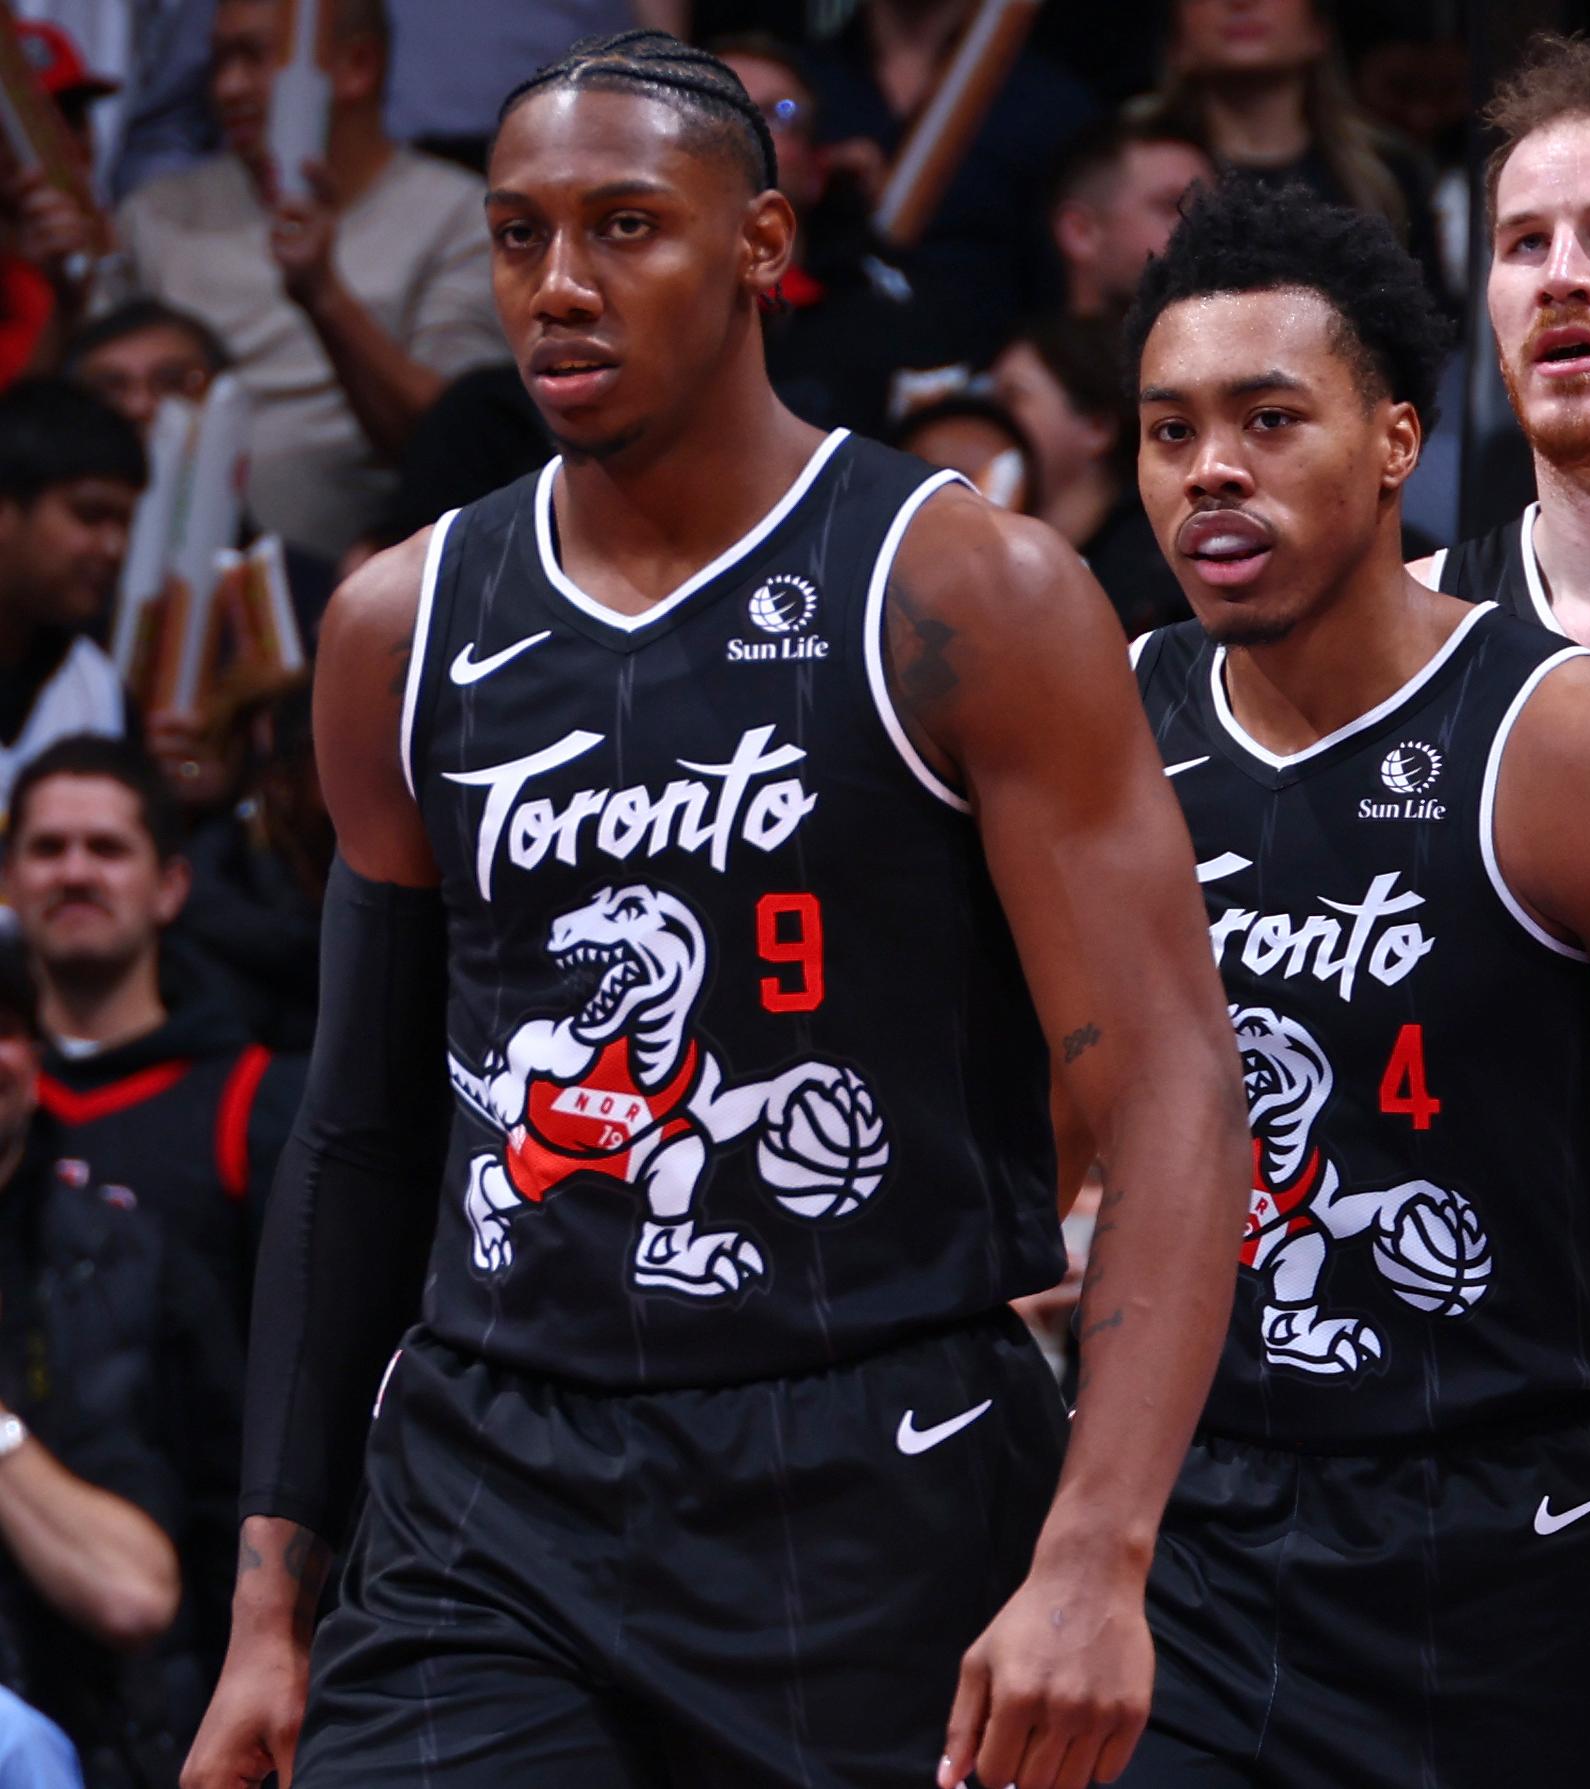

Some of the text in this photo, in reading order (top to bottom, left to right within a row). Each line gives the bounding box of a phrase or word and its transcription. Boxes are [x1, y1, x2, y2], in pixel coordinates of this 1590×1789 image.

[727, 634, 830, 661] Sun Life
[442, 723, 819, 903] Toronto
[1358, 798, 1446, 820] Sun Life
[757, 893, 824, 1013] 9
[1195, 851, 1437, 1003] ronto
[1380, 1024, 1441, 1131] 4
[597, 1124, 624, 1150] 19
